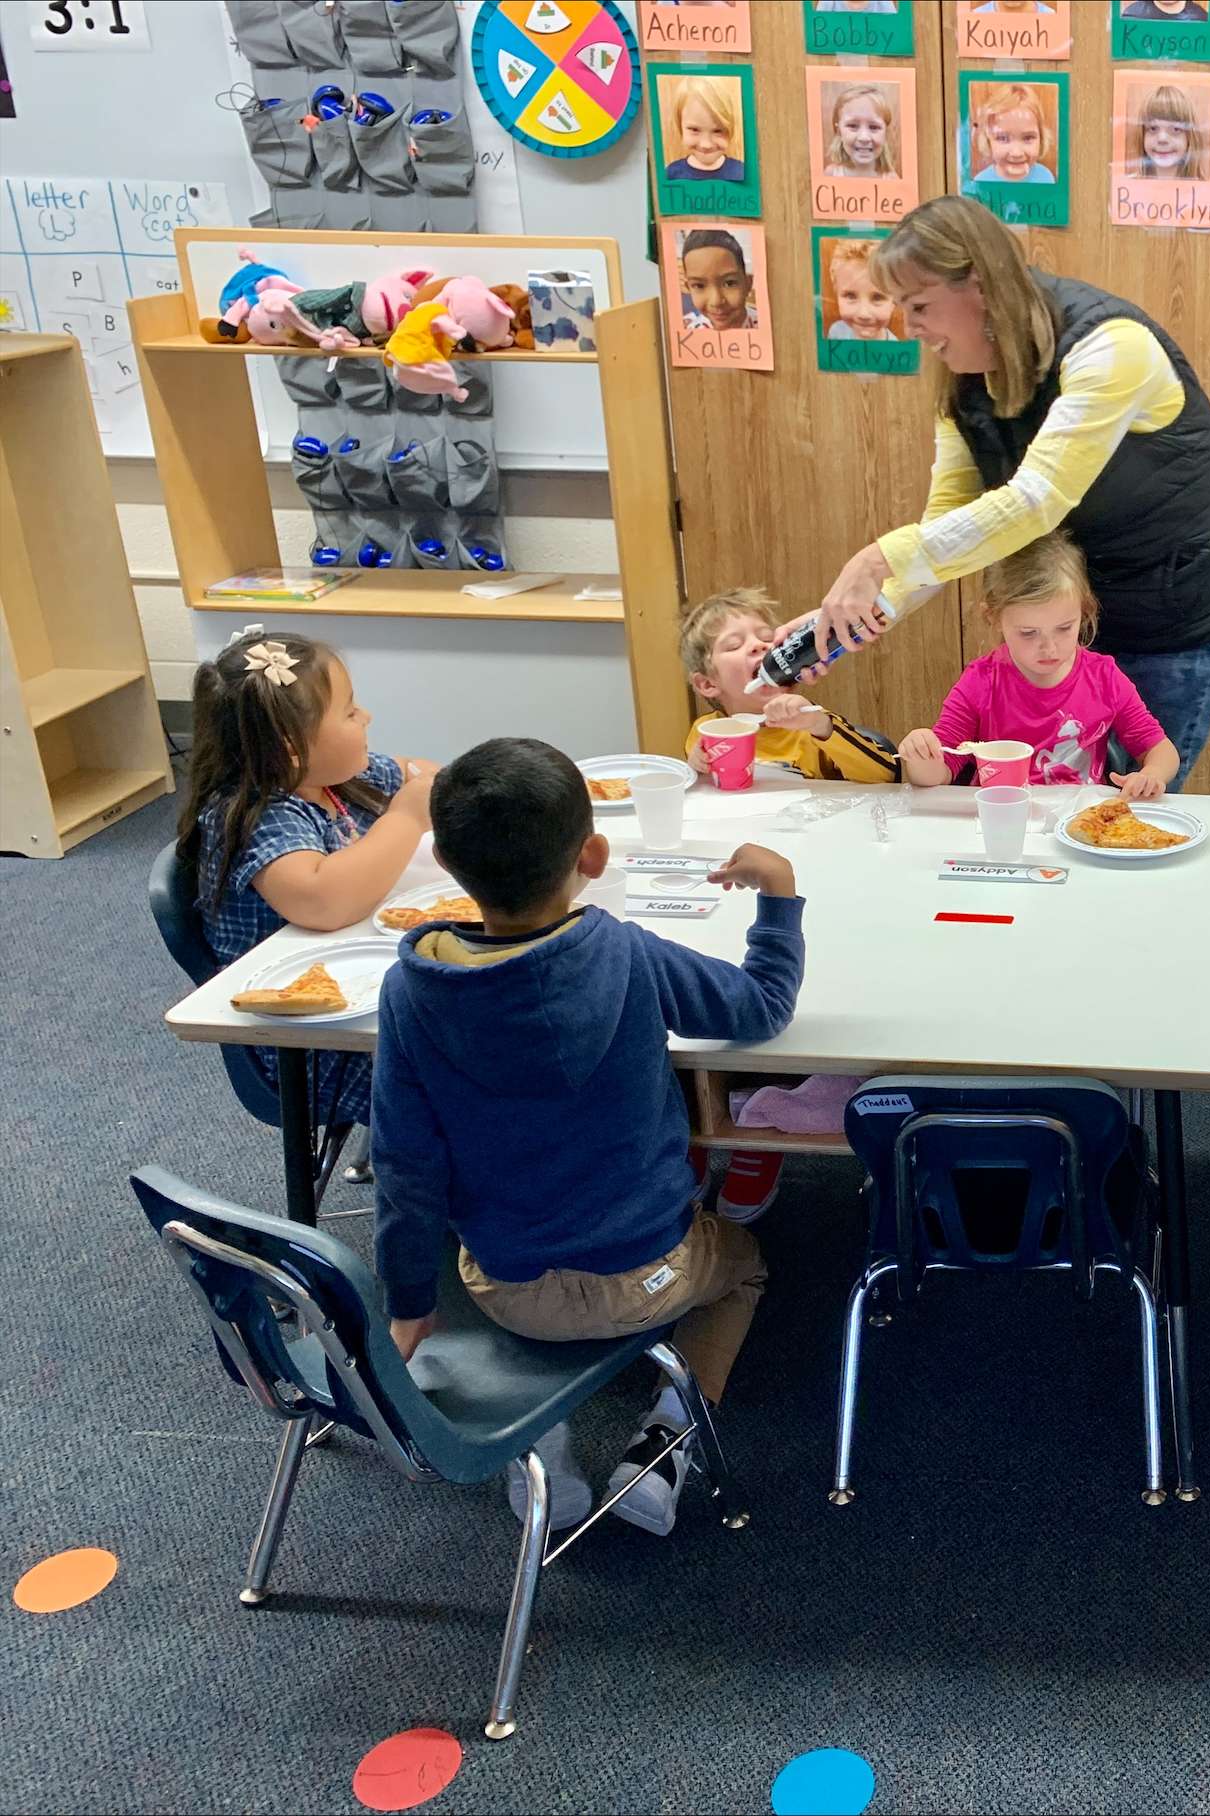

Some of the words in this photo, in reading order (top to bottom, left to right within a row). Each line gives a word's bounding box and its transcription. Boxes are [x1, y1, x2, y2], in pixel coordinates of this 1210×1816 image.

[646, 12, 737, 44] Acheron
[812, 16, 896, 51] Bobby
[966, 19, 1049, 56] Kaiyah
[1122, 23, 1207, 58] Kayson
[24, 181, 89, 210] letter
[123, 183, 189, 213] Word
[663, 184, 758, 213] Thaddeus
[815, 184, 904, 214] Charlee
[72, 271, 83, 288] P
[156, 279, 180, 290] cat
[104, 315, 116, 332] B
[676, 331, 763, 361] Kaleb
[828, 339, 912, 372] Kalvyn
[117, 361, 132, 376] h
[636, 858, 691, 868] Joseph
[951, 866, 1019, 876] Addyson
[645, 902, 692, 912] Kaleb
